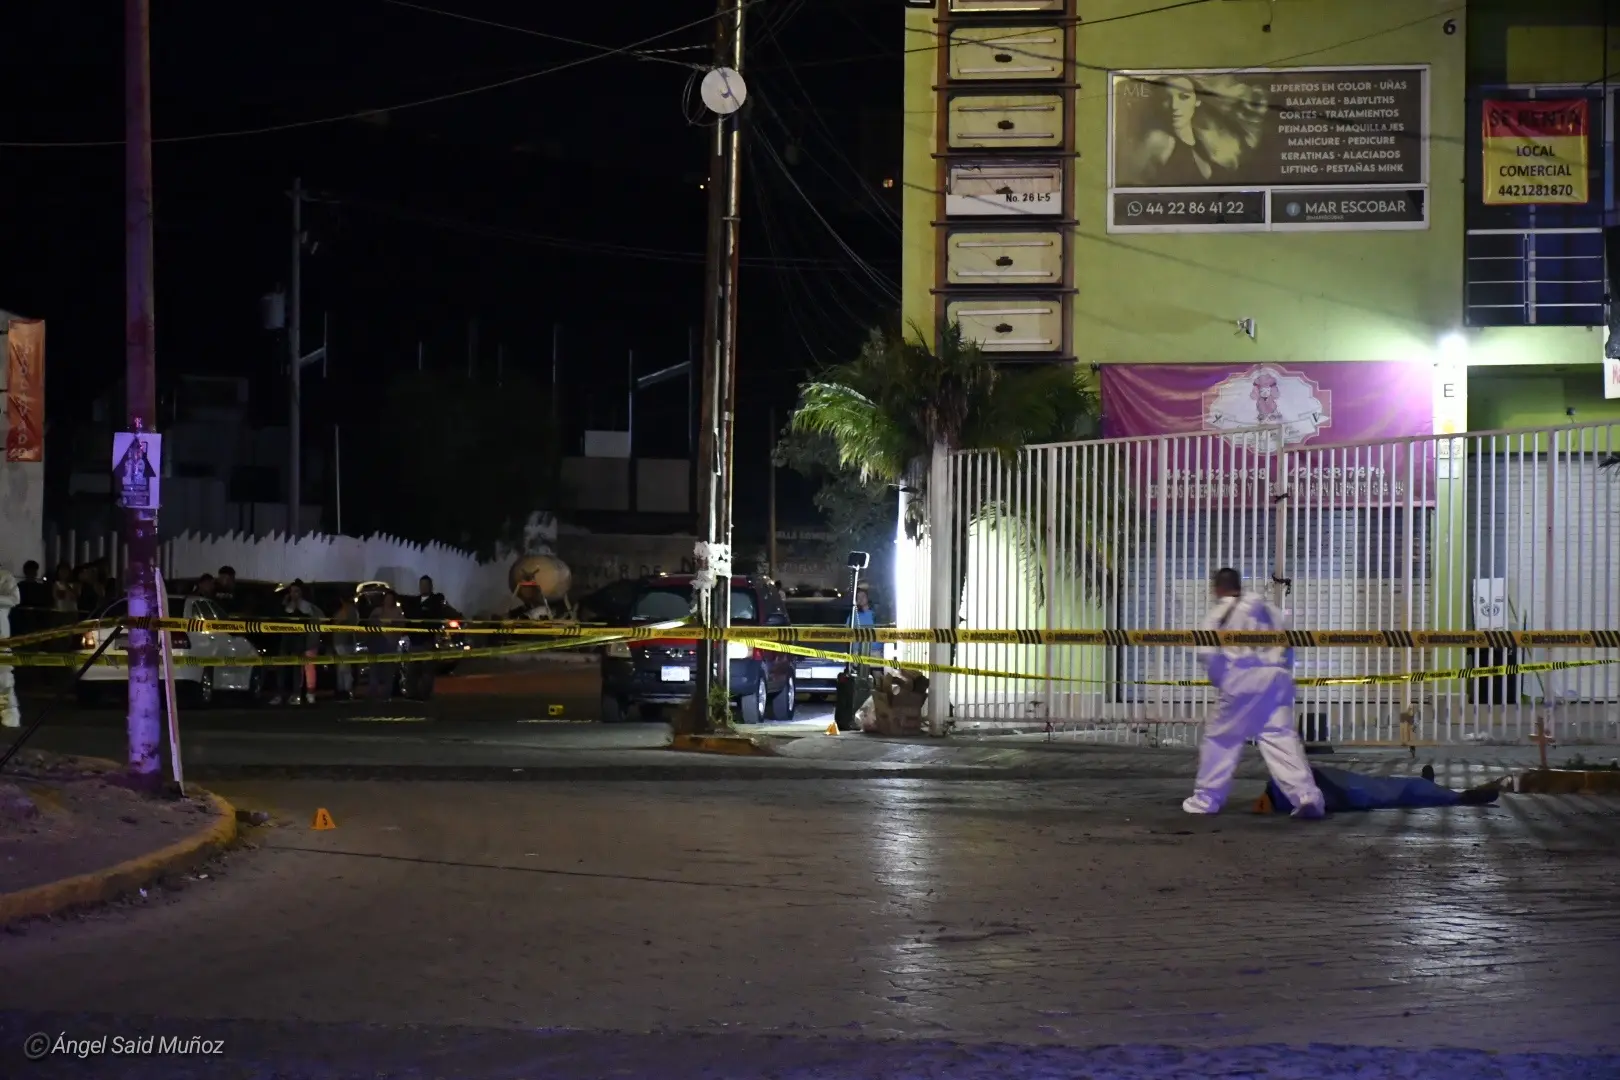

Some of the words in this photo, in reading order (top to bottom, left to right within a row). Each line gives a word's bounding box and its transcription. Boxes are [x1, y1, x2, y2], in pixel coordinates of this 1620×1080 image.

[1270, 83, 1320, 93] EXPERTOS
[1322, 82, 1335, 92] EN
[1336, 82, 1372, 91] COLOR
[1379, 79, 1407, 90] UÑAS
[1286, 96, 1336, 106] BALAYAGE
[1280, 110, 1317, 120] CORTES
[1325, 109, 1399, 119] TRATAMIENTOS
[1278, 124, 1329, 133] PEINADOS
[1336, 123, 1405, 133] MAQUILLAJES
[1288, 137, 1340, 146] MANICURE
[1348, 136, 1396, 145] PEDICURE
[1281, 151, 1335, 160] KERATINAS
[1343, 150, 1401, 159] ALACIADOS
[1516, 145, 1555, 157] LOCAL
[1280, 165, 1319, 174] LIFTING
[1326, 162, 1376, 173] PESTAÑAS
[1378, 164, 1404, 172] MINK
[1498, 184, 1573, 197] 4421281870
[1145, 202, 1164, 214] 44
[1167, 202, 1186, 214] 22
[1188, 202, 1206, 214] 86
[1209, 201, 1222, 214] 41
[1226, 201, 1244, 214] 22
[1305, 202, 1337, 214] MAR
[1341, 200, 1406, 213] ESCOBAR
